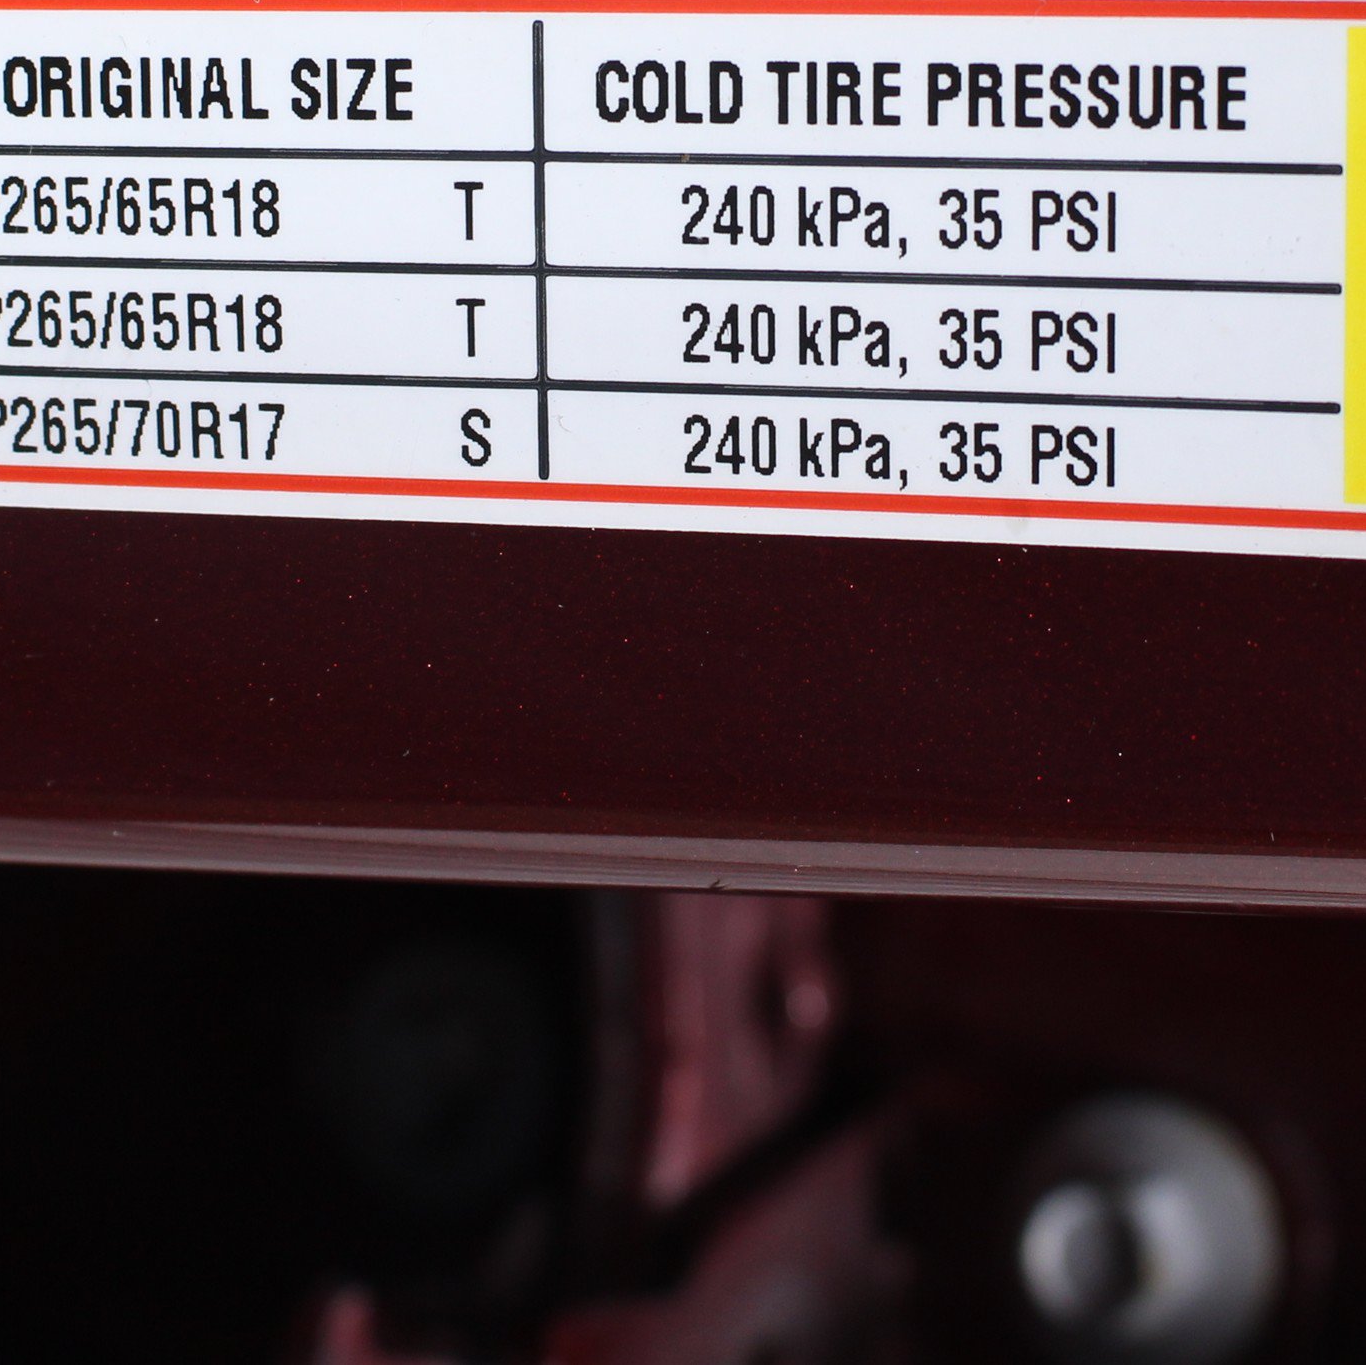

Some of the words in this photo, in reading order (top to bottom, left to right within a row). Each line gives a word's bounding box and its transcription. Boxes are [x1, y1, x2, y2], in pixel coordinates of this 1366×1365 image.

[4, 57, 268, 119] ORIGINAL
[292, 58, 412, 120] SIZE
[596, 61, 742, 123] COLD
[767, 62, 900, 125] TIRE
[928, 64, 1245, 130] PRESSURE
[454, 182, 483, 240] T
[682, 185, 774, 245] 240
[799, 187, 906, 257] kPa,
[940, 189, 1001, 249] 35
[1033, 191, 1115, 252] PSI
[456, 299, 485, 357] T
[683, 303, 775, 364] 240
[799, 306, 906, 377] kPa,
[940, 309, 1001, 369] 35
[1032, 311, 1115, 373] PSI
[461, 409, 491, 466] S
[685, 415, 776, 475] 240
[800, 418, 907, 490] kPa,
[940, 423, 1001, 482] 35
[1032, 425, 1114, 487] PSI
